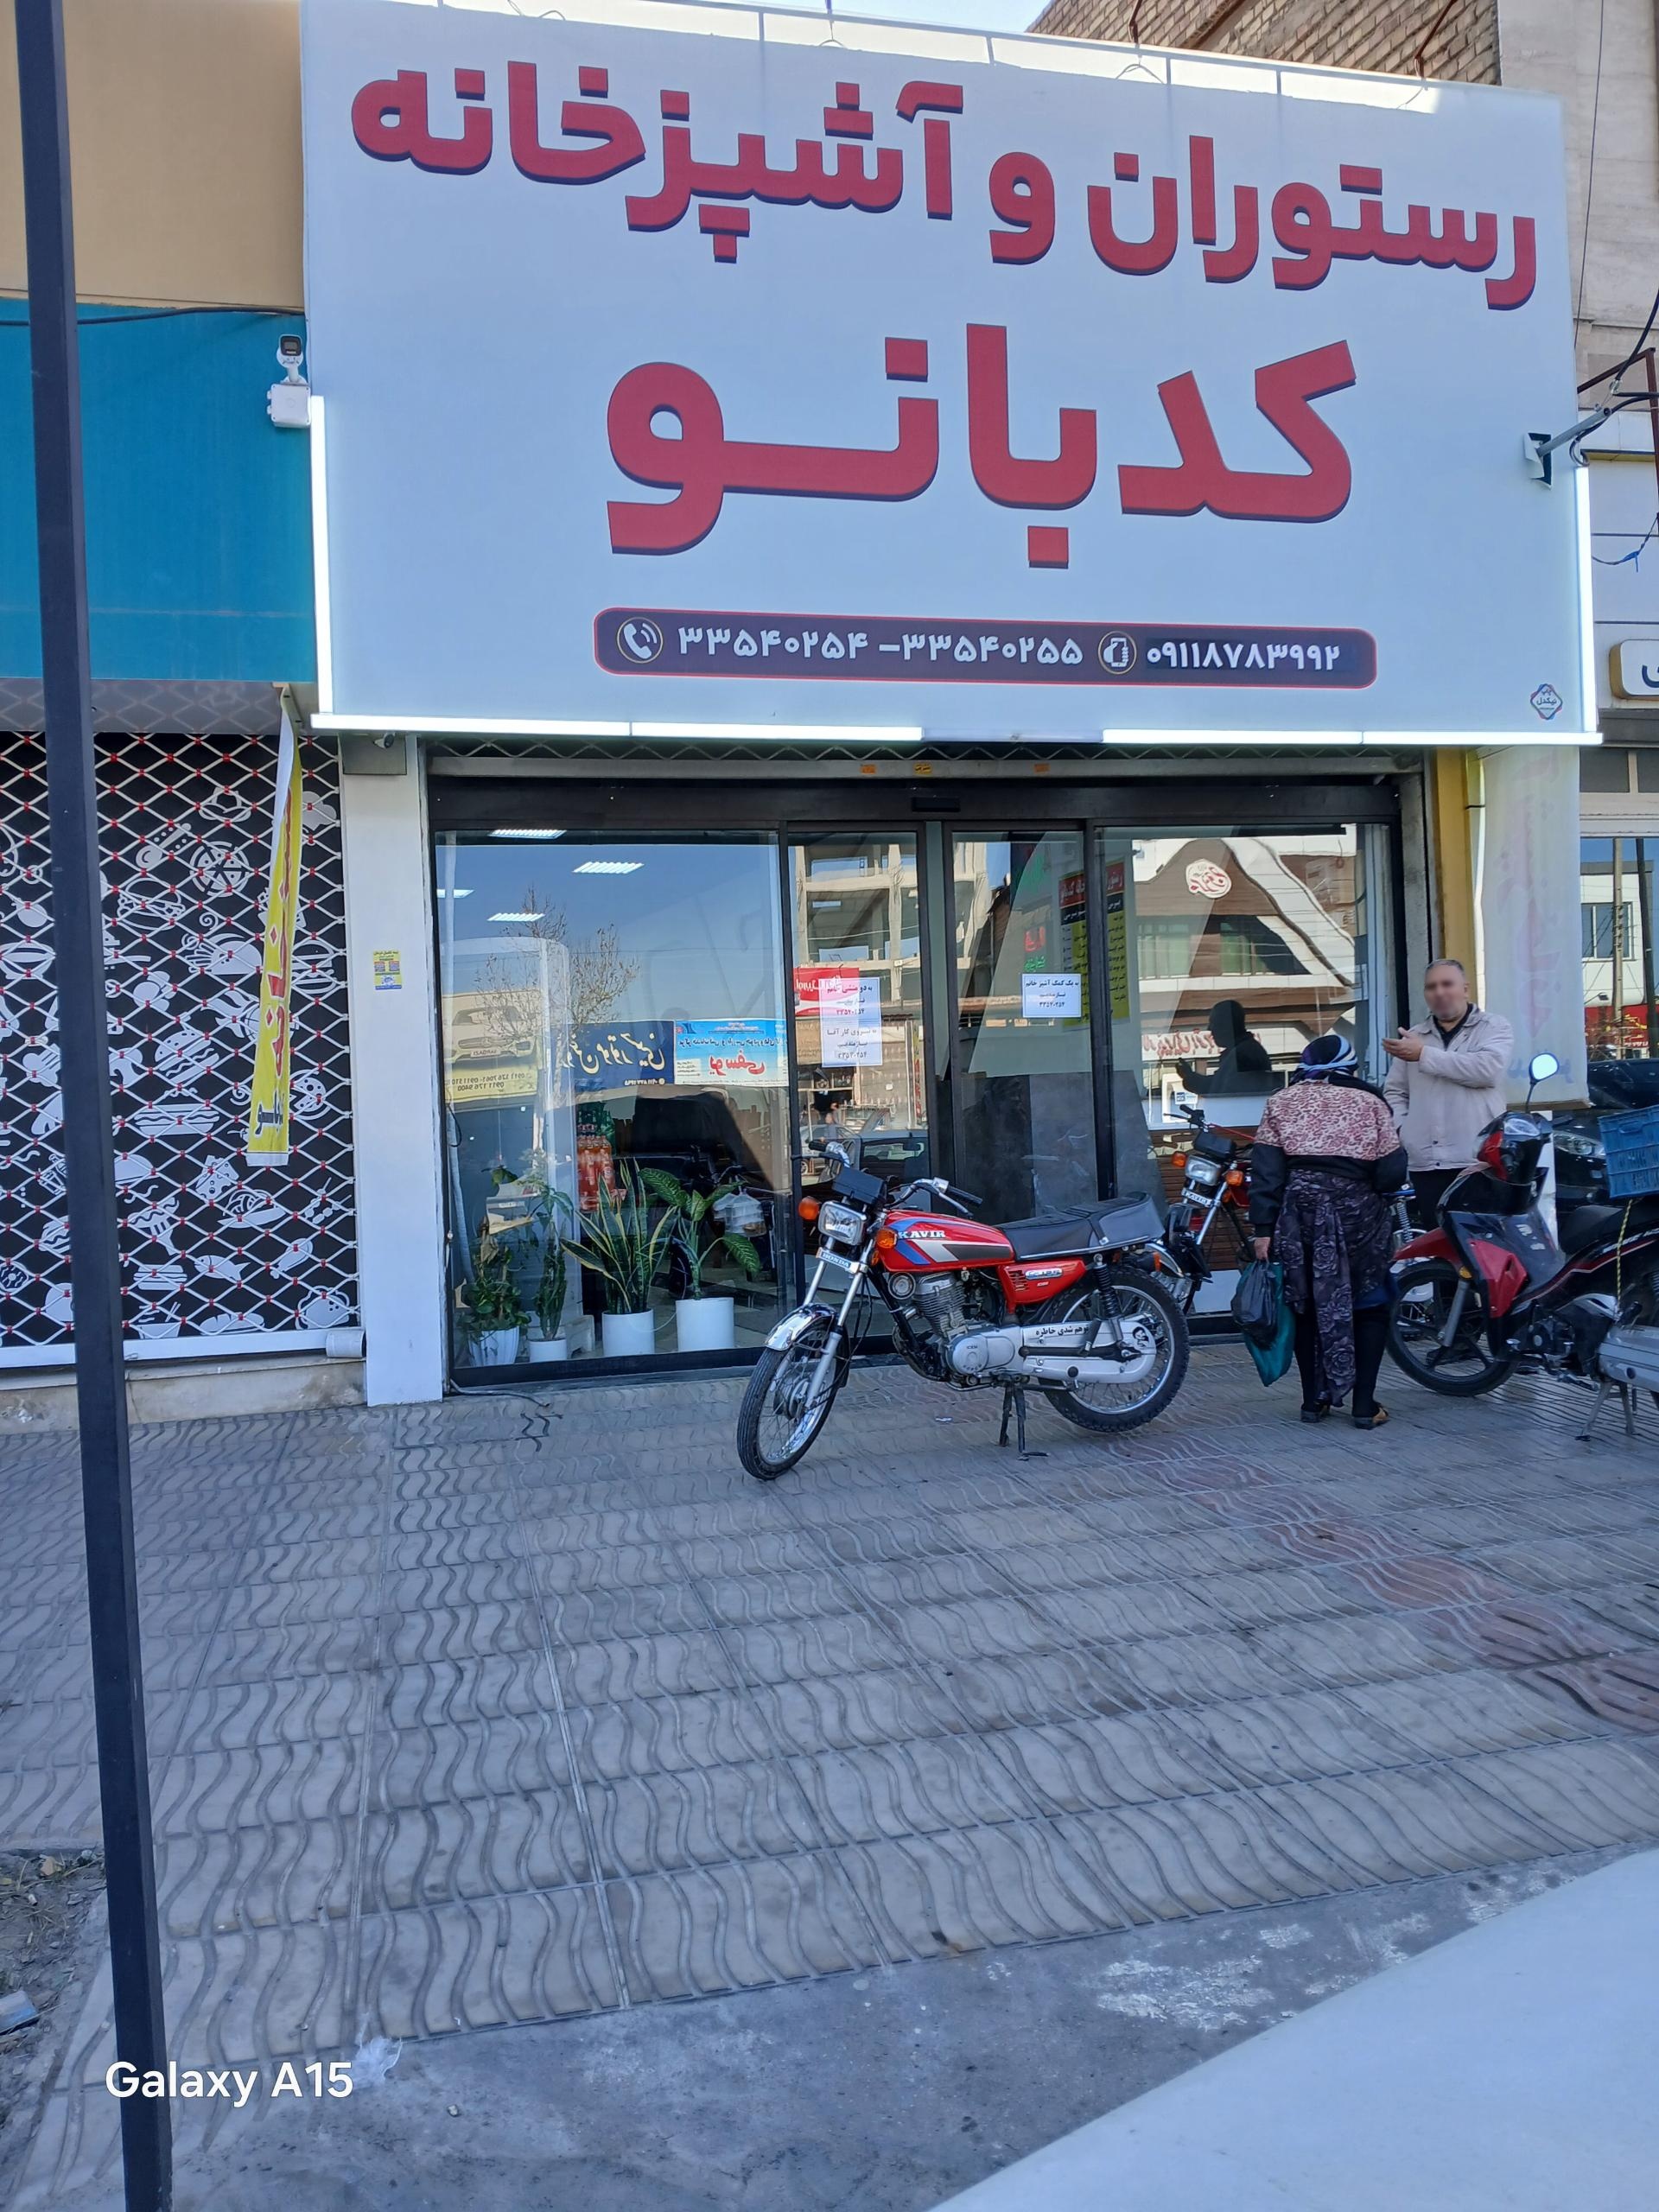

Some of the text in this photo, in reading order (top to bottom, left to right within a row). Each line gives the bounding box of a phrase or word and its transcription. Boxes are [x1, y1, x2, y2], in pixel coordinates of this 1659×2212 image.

[351, 60, 1537, 310] رستوران و آشپزخانه
[607, 322, 1357, 569] کدبانو
[677, 626, 868, 661] ۳۳۵۴۰۲۵۴
[1145, 639, 1341, 673] ۰۹۱۱۸۷۸۳۹۹۲
[897, 1230, 946, 1239] KAVIR
[822, 1252, 849, 1268] HONDA
